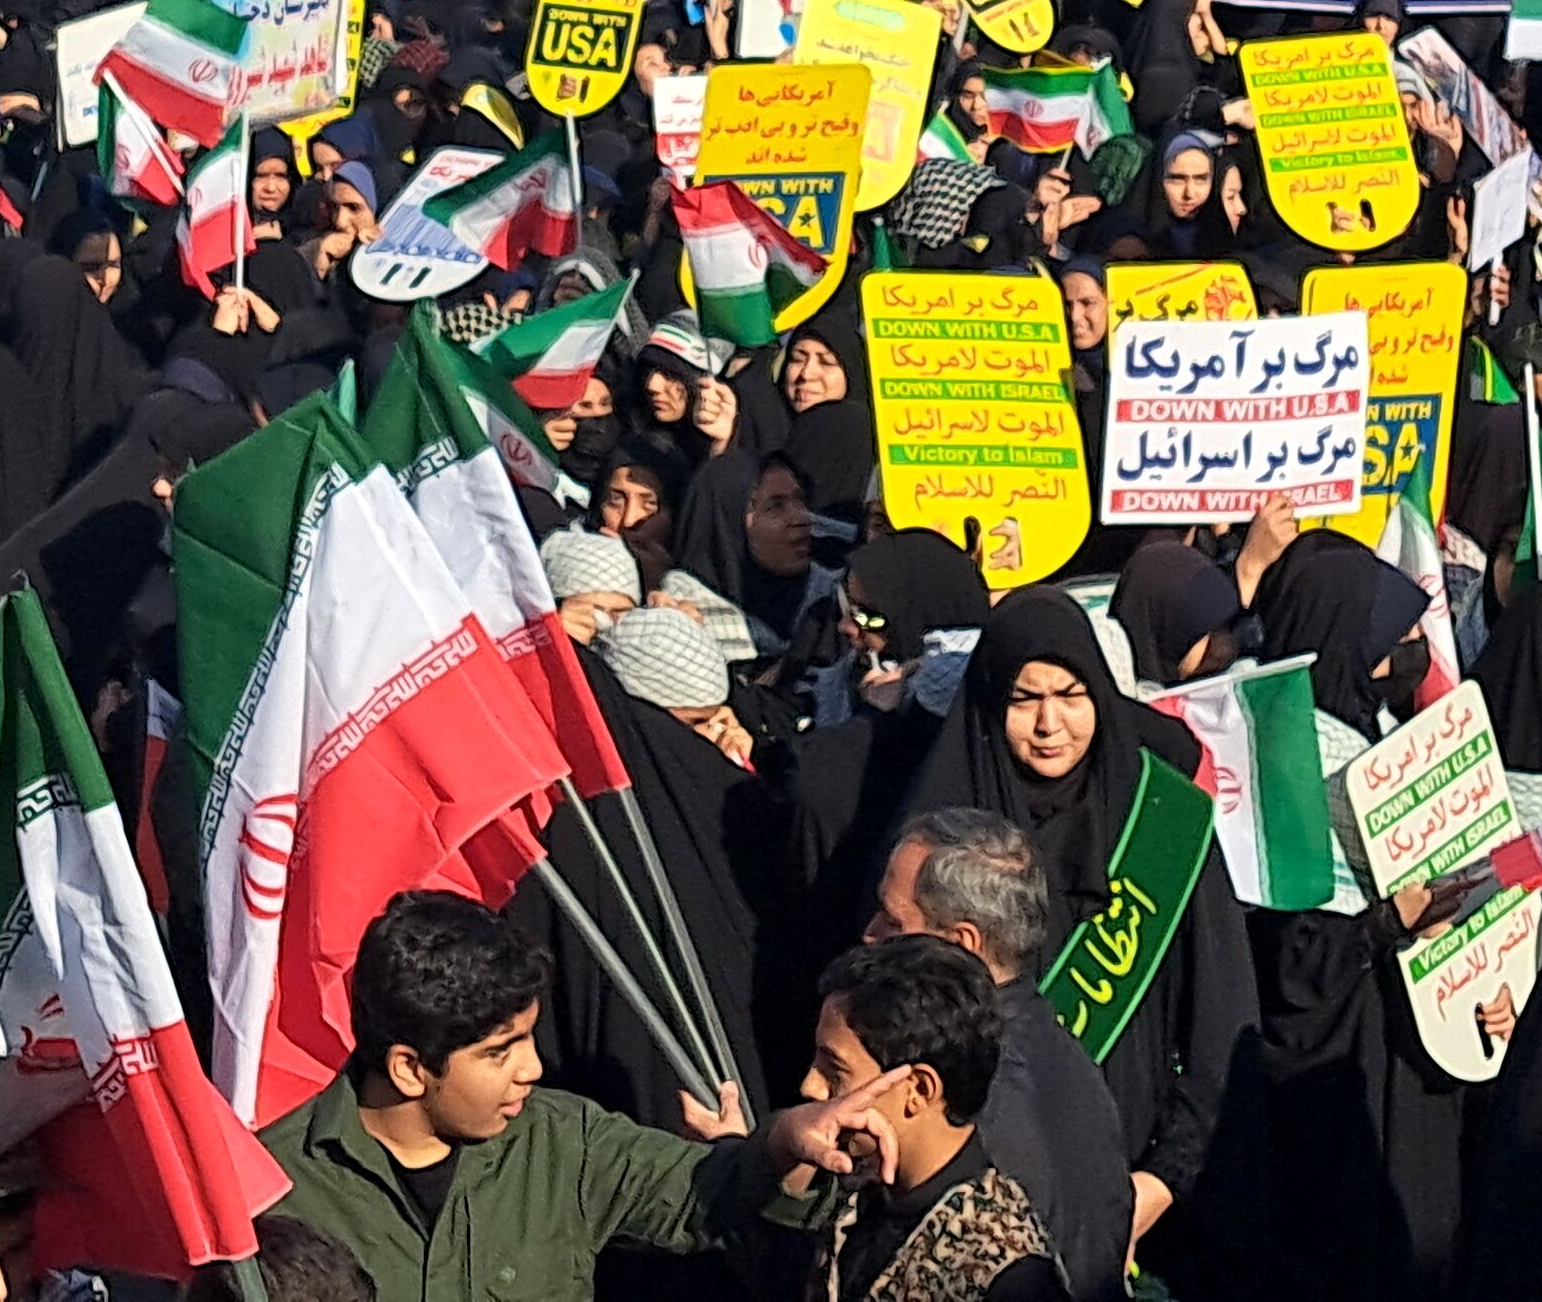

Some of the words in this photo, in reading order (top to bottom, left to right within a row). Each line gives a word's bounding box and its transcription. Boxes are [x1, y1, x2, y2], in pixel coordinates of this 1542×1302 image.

[542, 21, 617, 68] USA
[780, 178, 834, 195] WITH
[963, 294, 985, 317] بر
[992, 285, 1039, 317] مرگ
[878, 320, 941, 337] DOWN
[945, 322, 997, 339] WITH
[1123, 328, 1256, 395] آمریکا
[1249, 346, 1287, 395] بر
[1293, 329, 1359, 389] مرگ
[884, 381, 942, 397] DOWN
[946, 382, 996, 398] WITH
[1000, 383, 1064, 400] ISRAEL
[1130, 398, 1216, 422] DOWN
[1222, 397, 1285, 419] WITH
[1385, 402, 1432, 422] WITH
[903, 444, 977, 465] Victory
[982, 447, 1003, 463] to
[1008, 447, 1063, 466] Islam
[1115, 425, 1254, 484] اسرائیل
[1255, 440, 1289, 483] بر
[1296, 424, 1358, 476] مرگ
[1123, 491, 1199, 513] DOWN
[1205, 488, 1266, 511] WITH
[1439, 700, 1473, 741] مرگ
[1367, 788, 1416, 834] DOWN
[1413, 766, 1454, 800] WITH
[1430, 836, 1467, 874] WITH
[1465, 802, 1509, 848] ISRAEL
[1417, 924, 1471, 972] Victory
[1467, 912, 1486, 935] to
